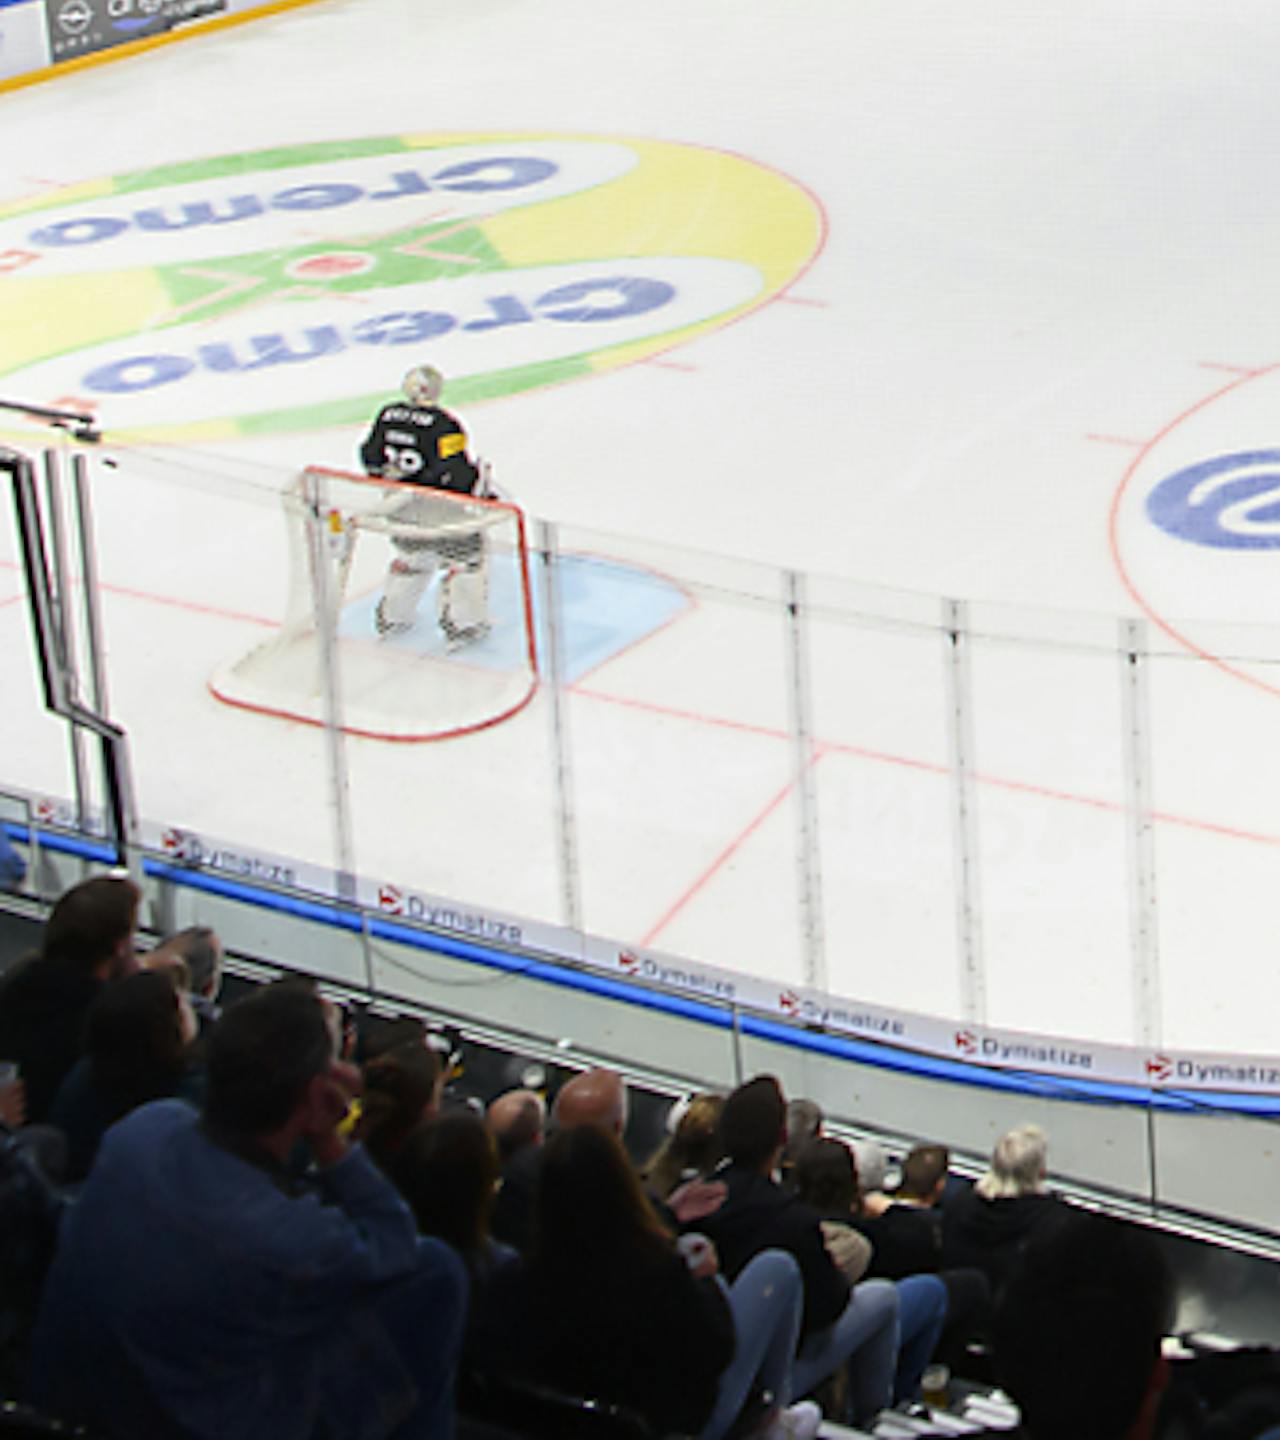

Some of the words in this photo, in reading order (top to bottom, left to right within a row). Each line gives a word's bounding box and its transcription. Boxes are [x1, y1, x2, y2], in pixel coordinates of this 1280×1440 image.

[408, 896, 523, 944] Dymatize
[643, 960, 736, 997] Dymatize
[803, 999, 905, 1037] Dymatize
[981, 1037, 1094, 1069] Dymatize
